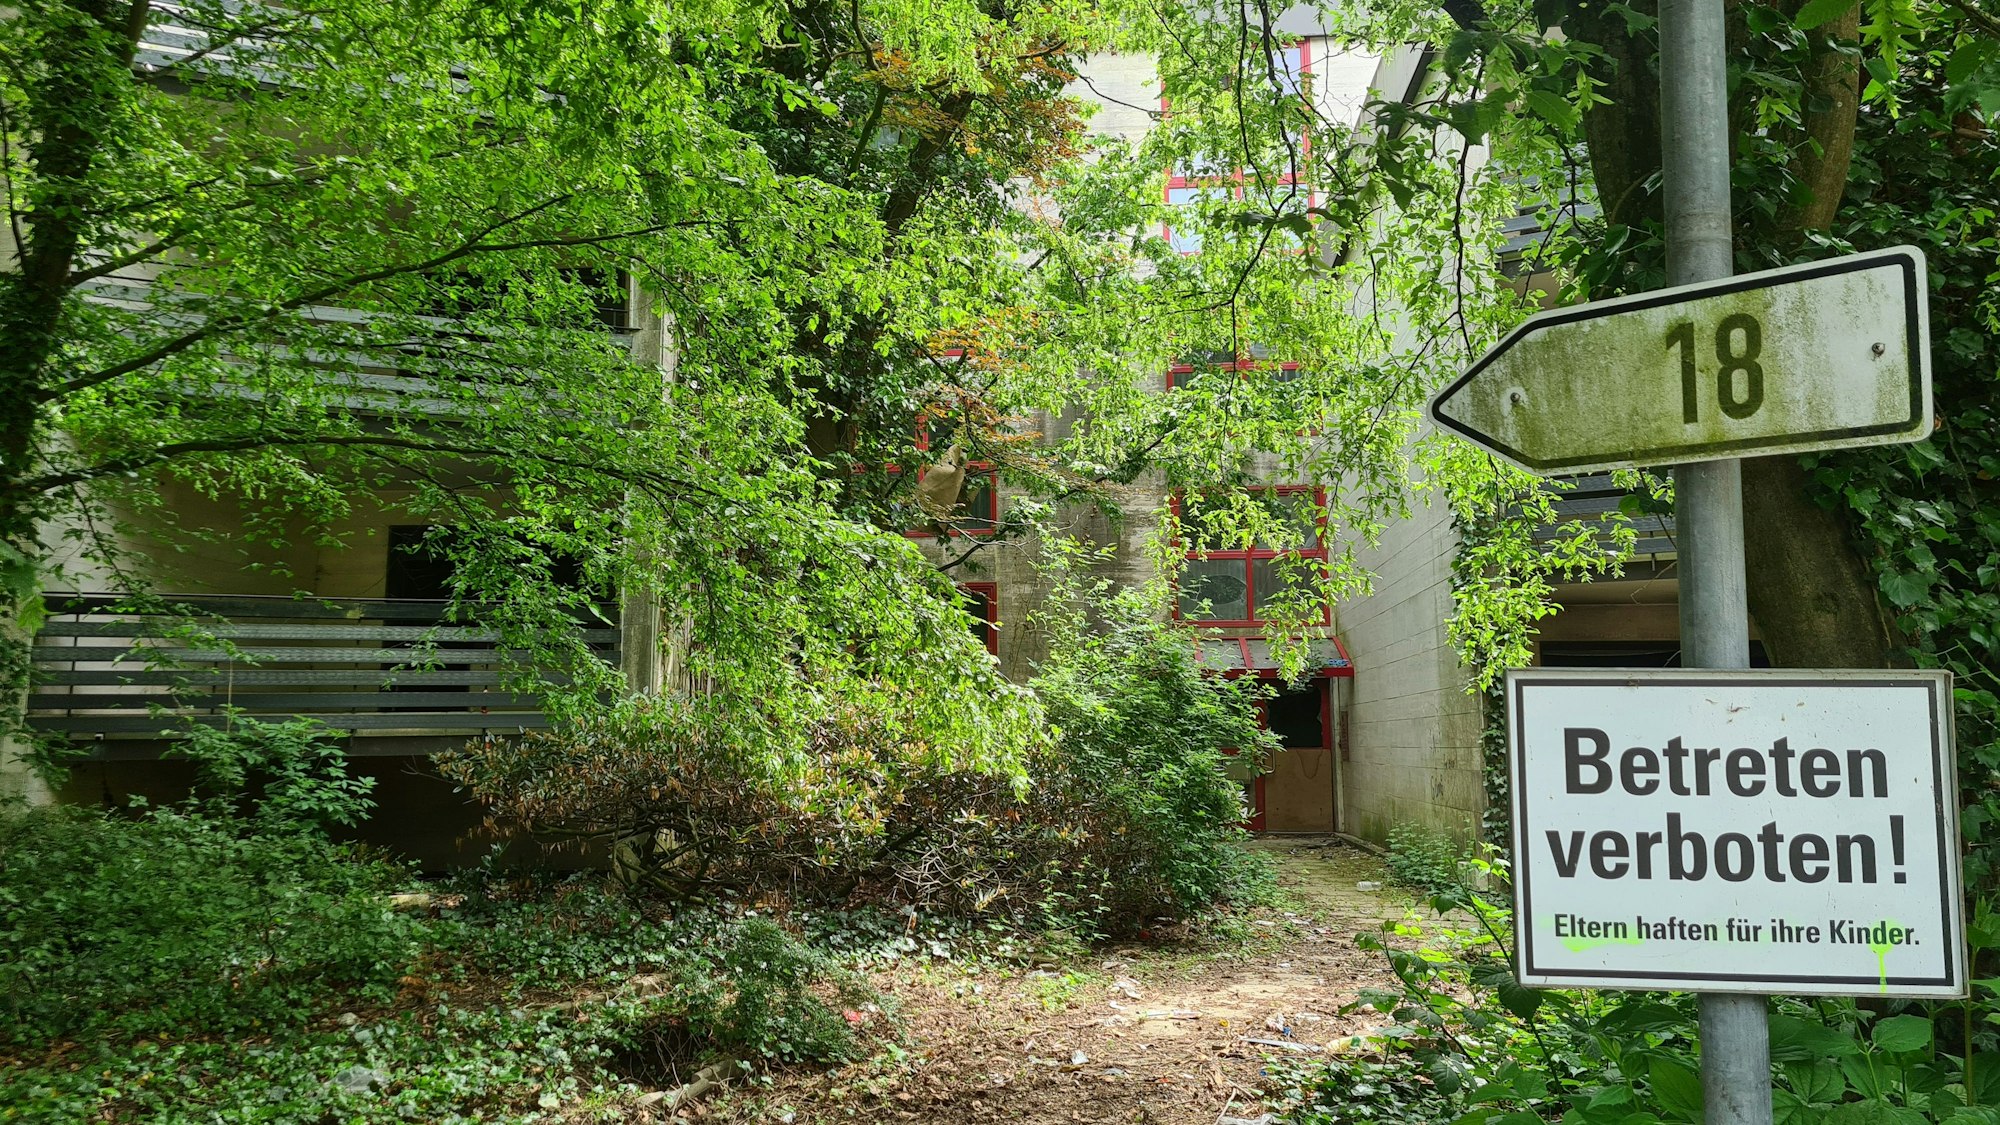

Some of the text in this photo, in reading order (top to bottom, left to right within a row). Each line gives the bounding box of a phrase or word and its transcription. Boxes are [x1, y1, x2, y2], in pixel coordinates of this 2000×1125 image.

[1665, 311, 1765, 425] 18
[1563, 727, 1889, 798] Betreten
[1545, 812, 1907, 884] verboten!
[1554, 913, 1921, 946] Eltern haften für ihre Kinder.
